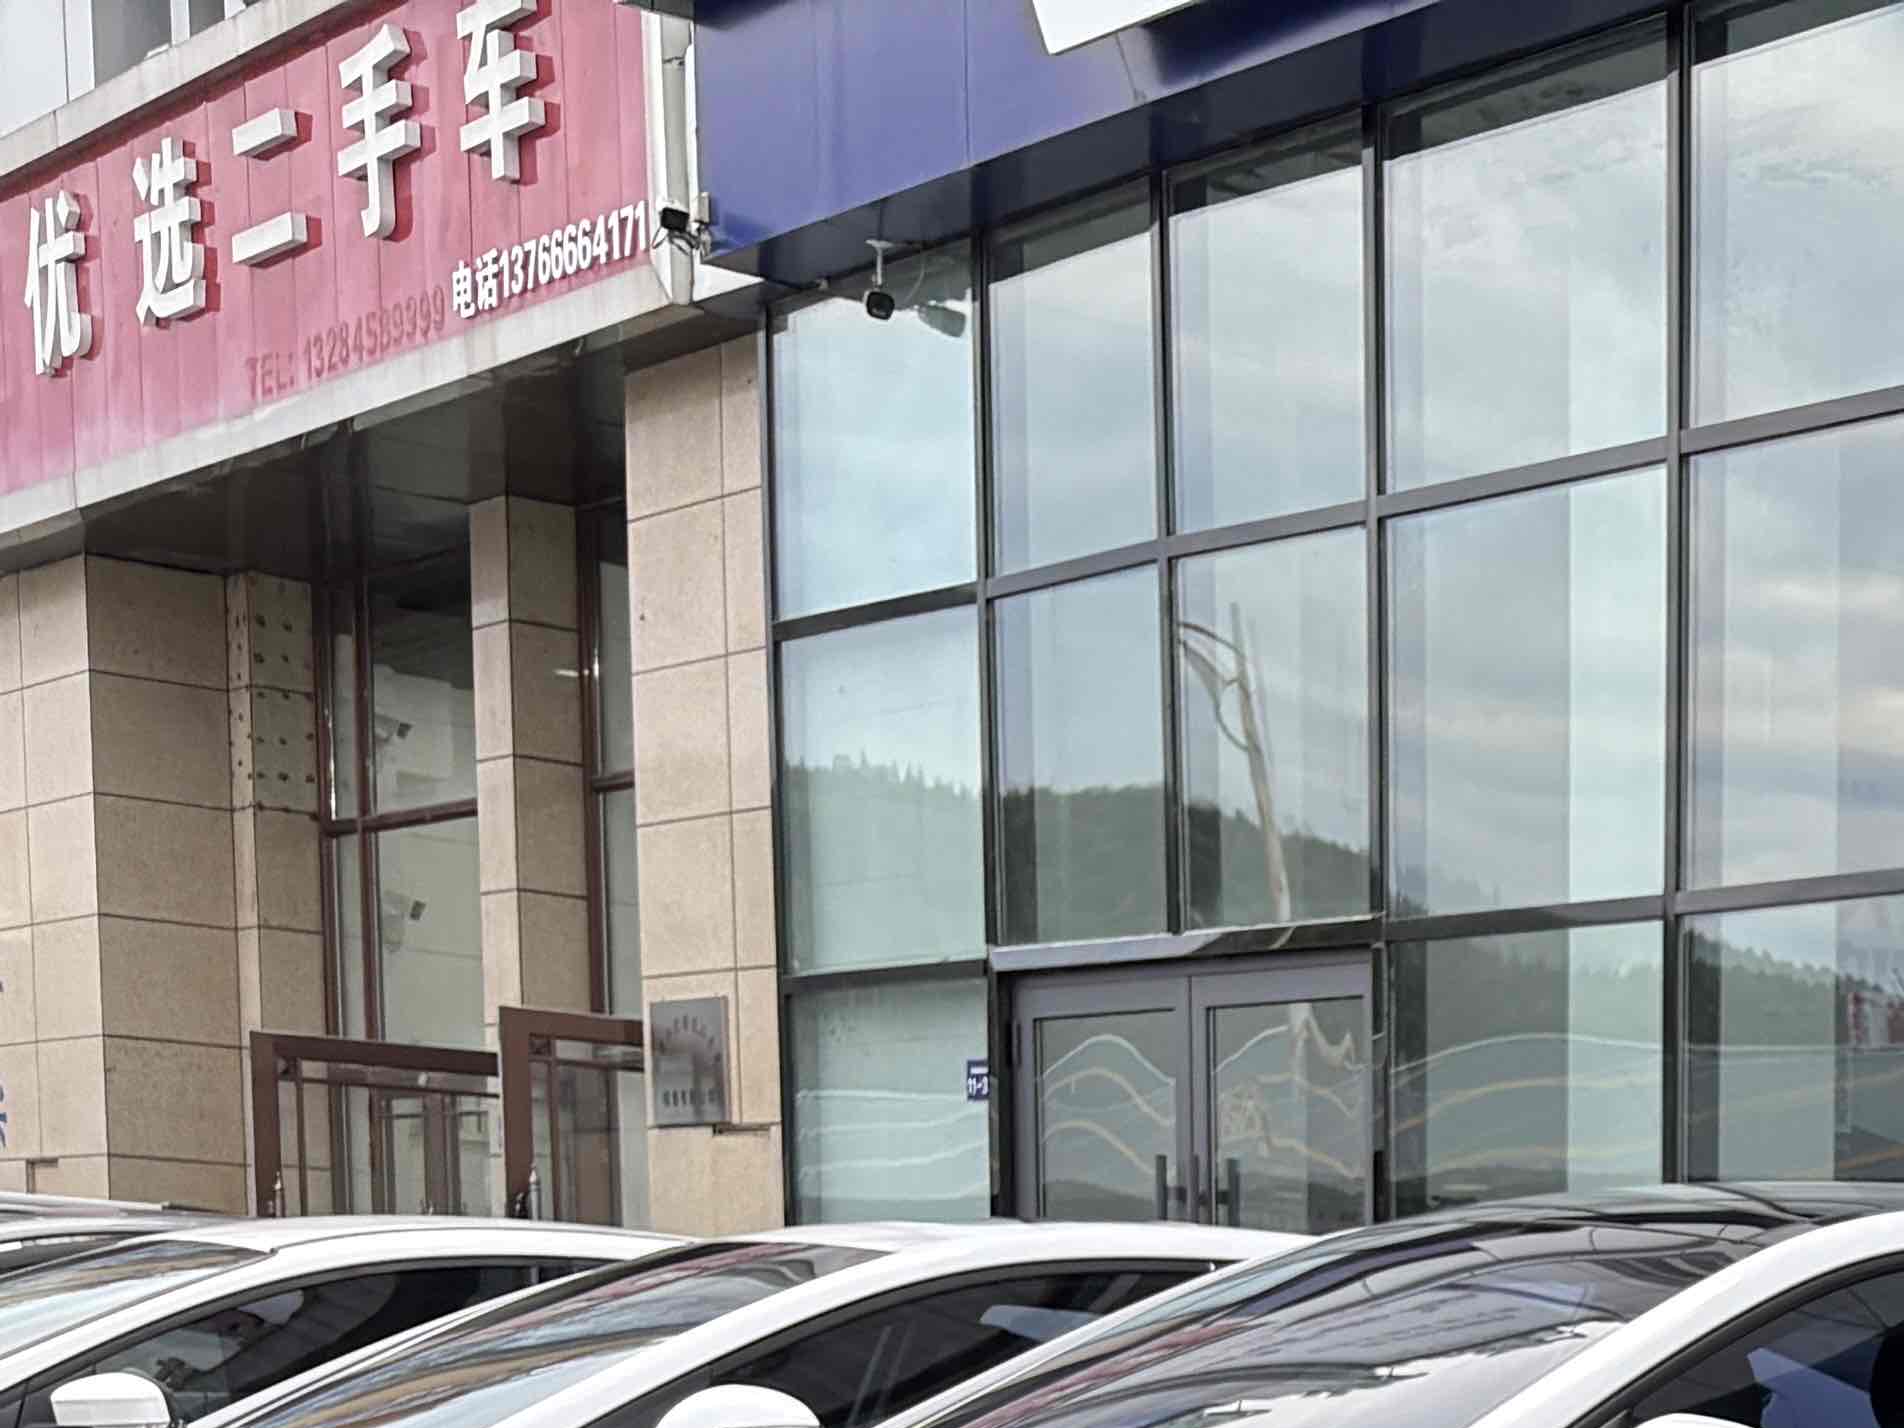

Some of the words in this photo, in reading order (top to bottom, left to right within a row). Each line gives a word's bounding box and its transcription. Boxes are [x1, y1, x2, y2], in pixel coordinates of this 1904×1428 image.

[24, 0, 546, 376] 优选二手车
[452, 200, 649, 320] 电话13766664171
